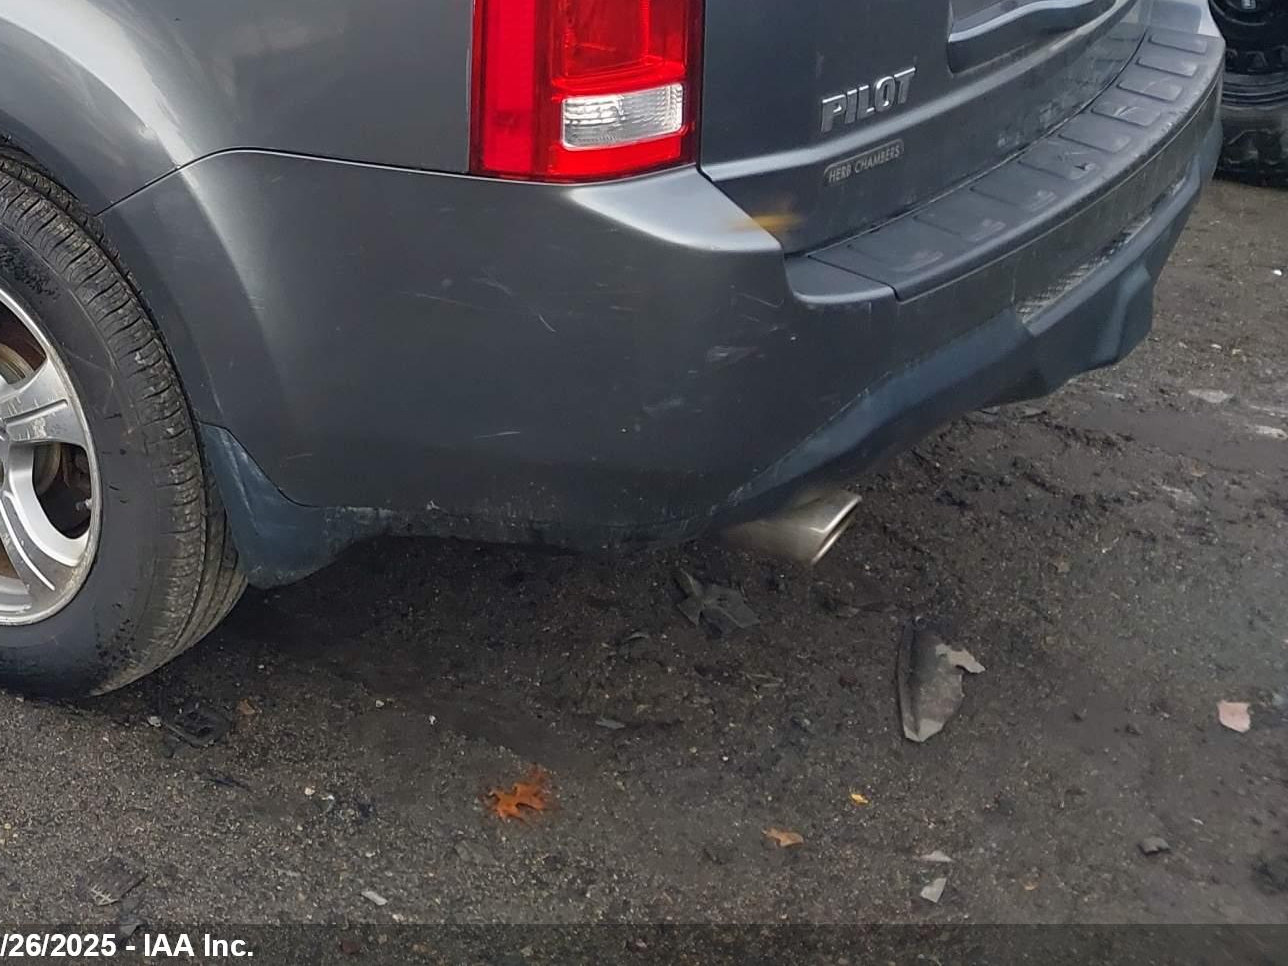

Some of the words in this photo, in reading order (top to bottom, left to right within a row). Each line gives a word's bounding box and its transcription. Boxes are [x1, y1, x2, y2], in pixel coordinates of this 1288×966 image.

[819, 66, 917, 133] PILOT
[828, 163, 852, 183] HERB
[854, 145, 900, 174] CHAMBERS
